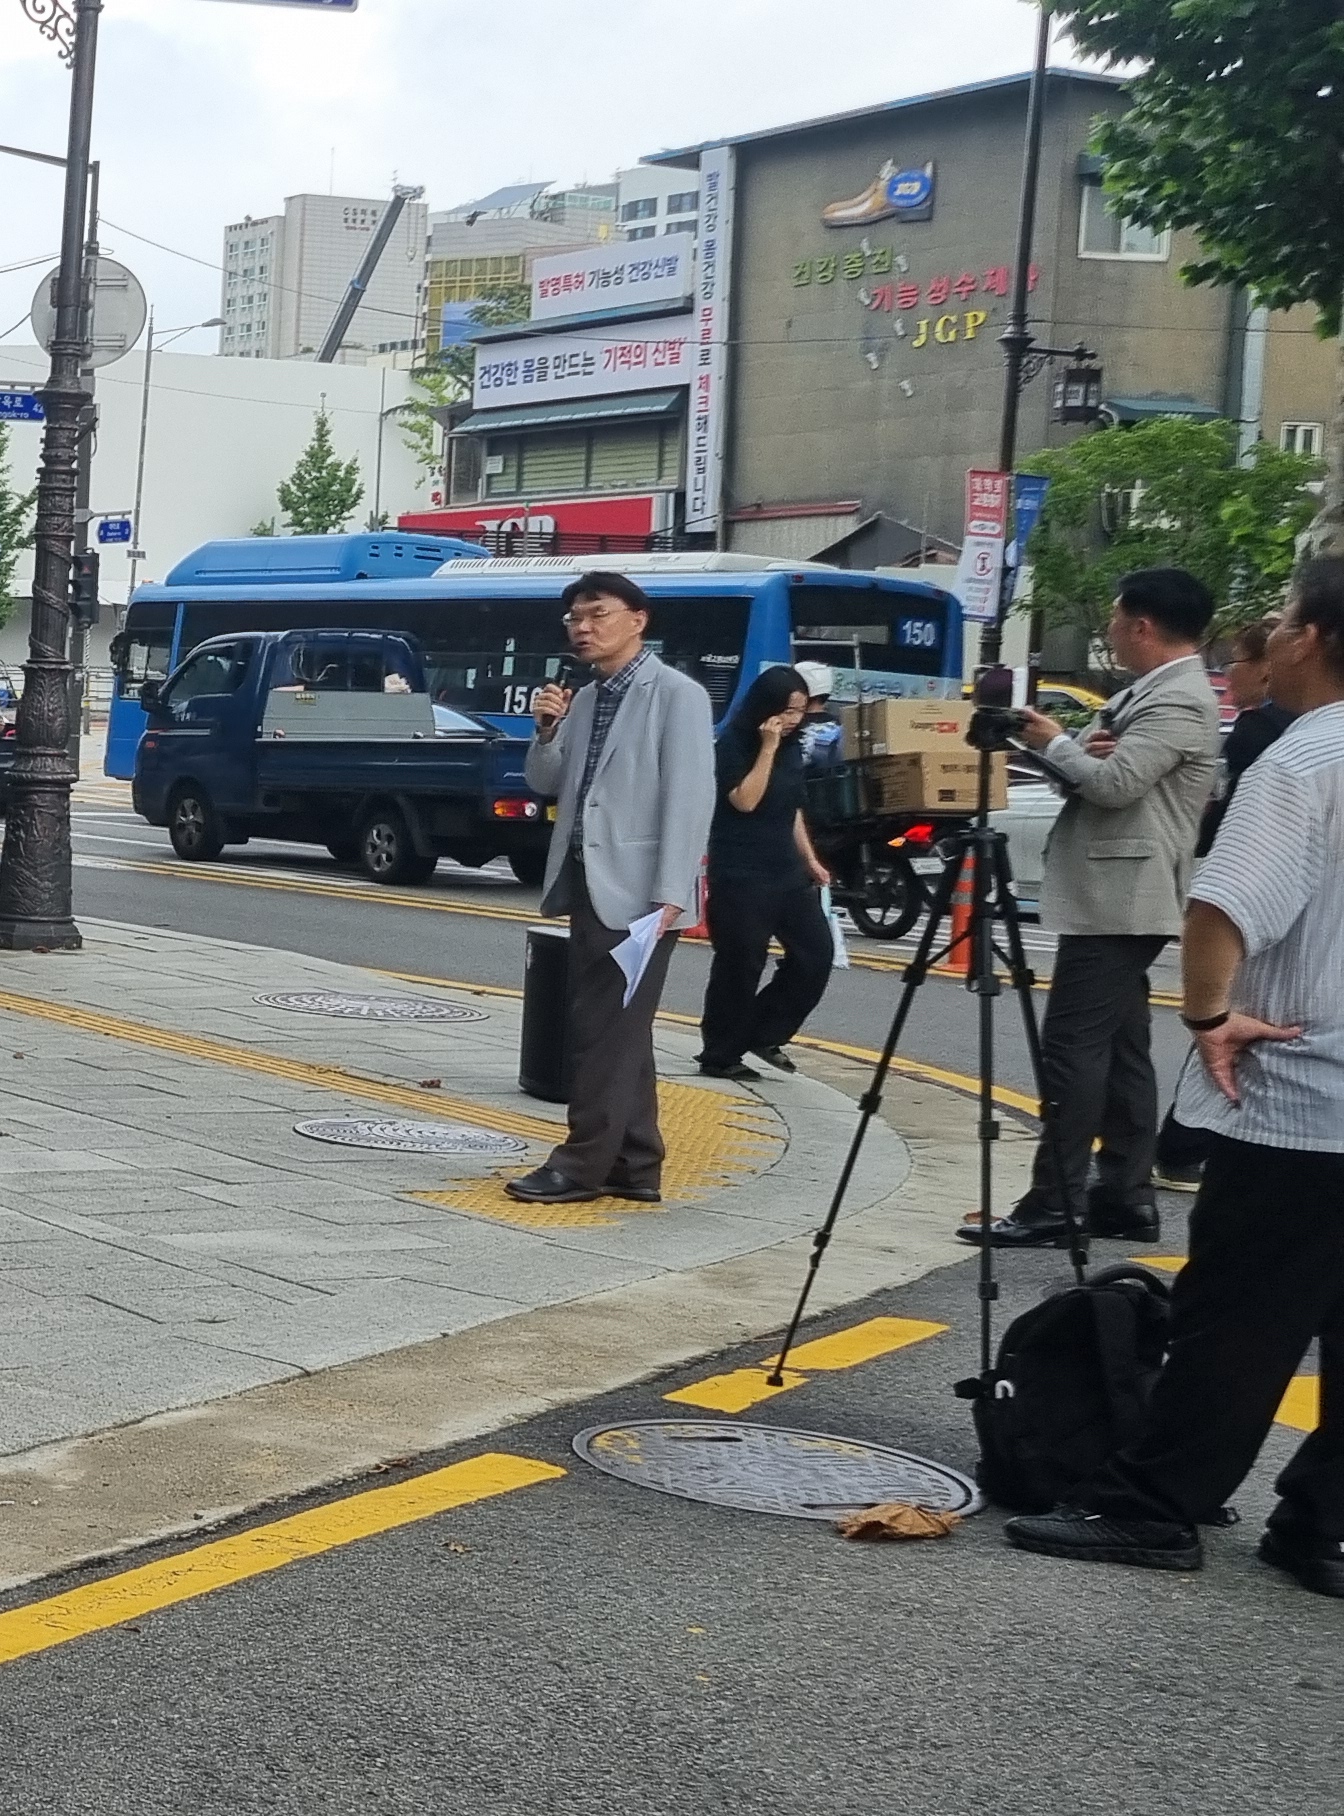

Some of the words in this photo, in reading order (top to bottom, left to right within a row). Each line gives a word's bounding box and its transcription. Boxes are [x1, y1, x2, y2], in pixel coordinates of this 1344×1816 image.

[538, 271, 586, 299] 발명특허
[587, 264, 626, 290] 기능성
[628, 254, 679, 284] 건강신발
[792, 247, 894, 287] 건강증진
[912, 310, 988, 349] JGP
[478, 360, 520, 390] 건강한
[521, 356, 548, 384] 몸을
[553, 350, 596, 380] 만드는
[903, 618, 936, 649] 150
